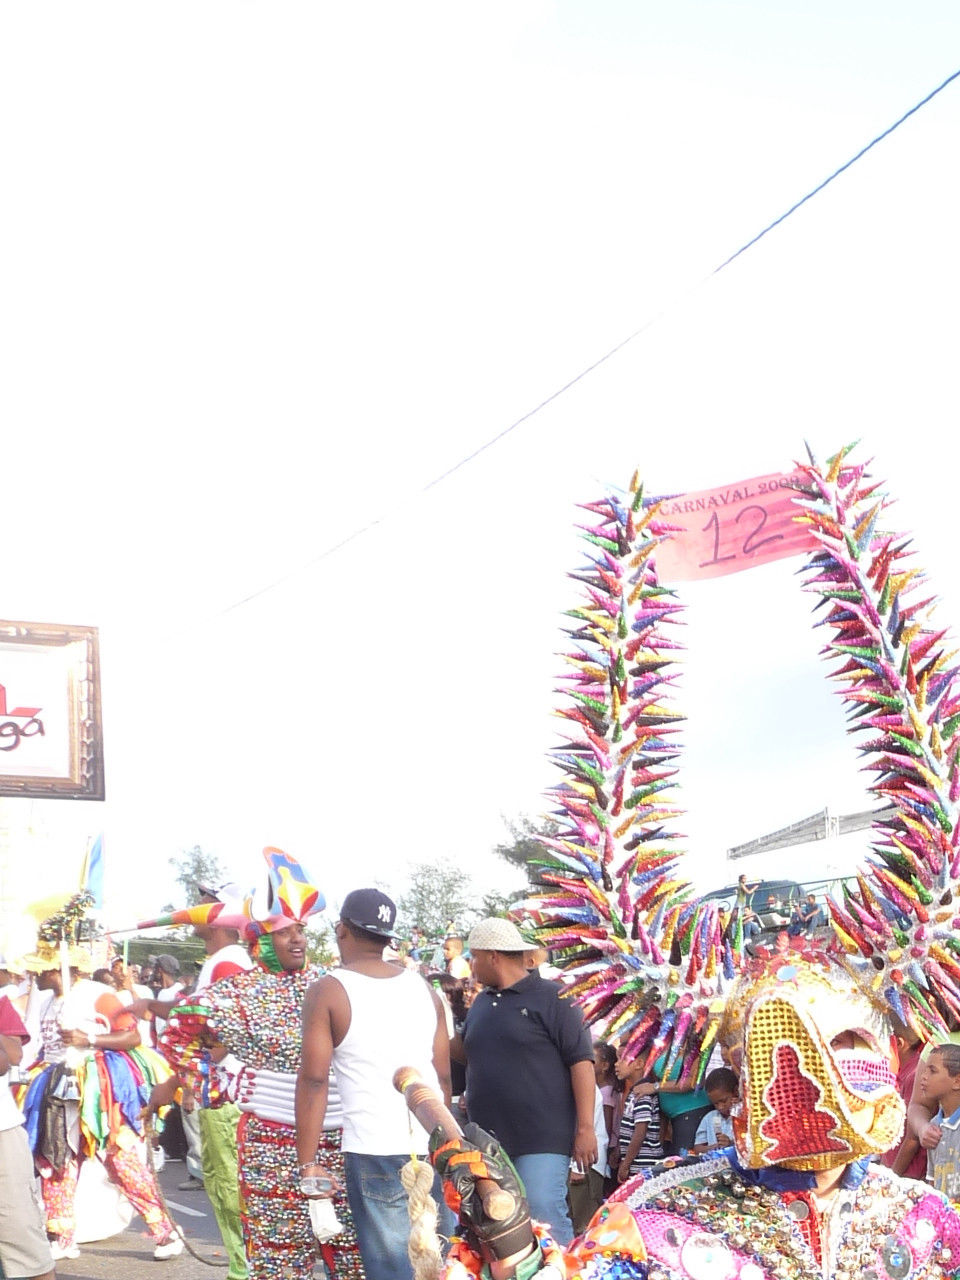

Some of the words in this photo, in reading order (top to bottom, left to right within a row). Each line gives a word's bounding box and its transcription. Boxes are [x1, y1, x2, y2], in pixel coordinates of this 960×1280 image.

[658, 486, 754, 516] CARNAVAL
[699, 505, 784, 568] 12
[377, 903, 392, 923] NY
